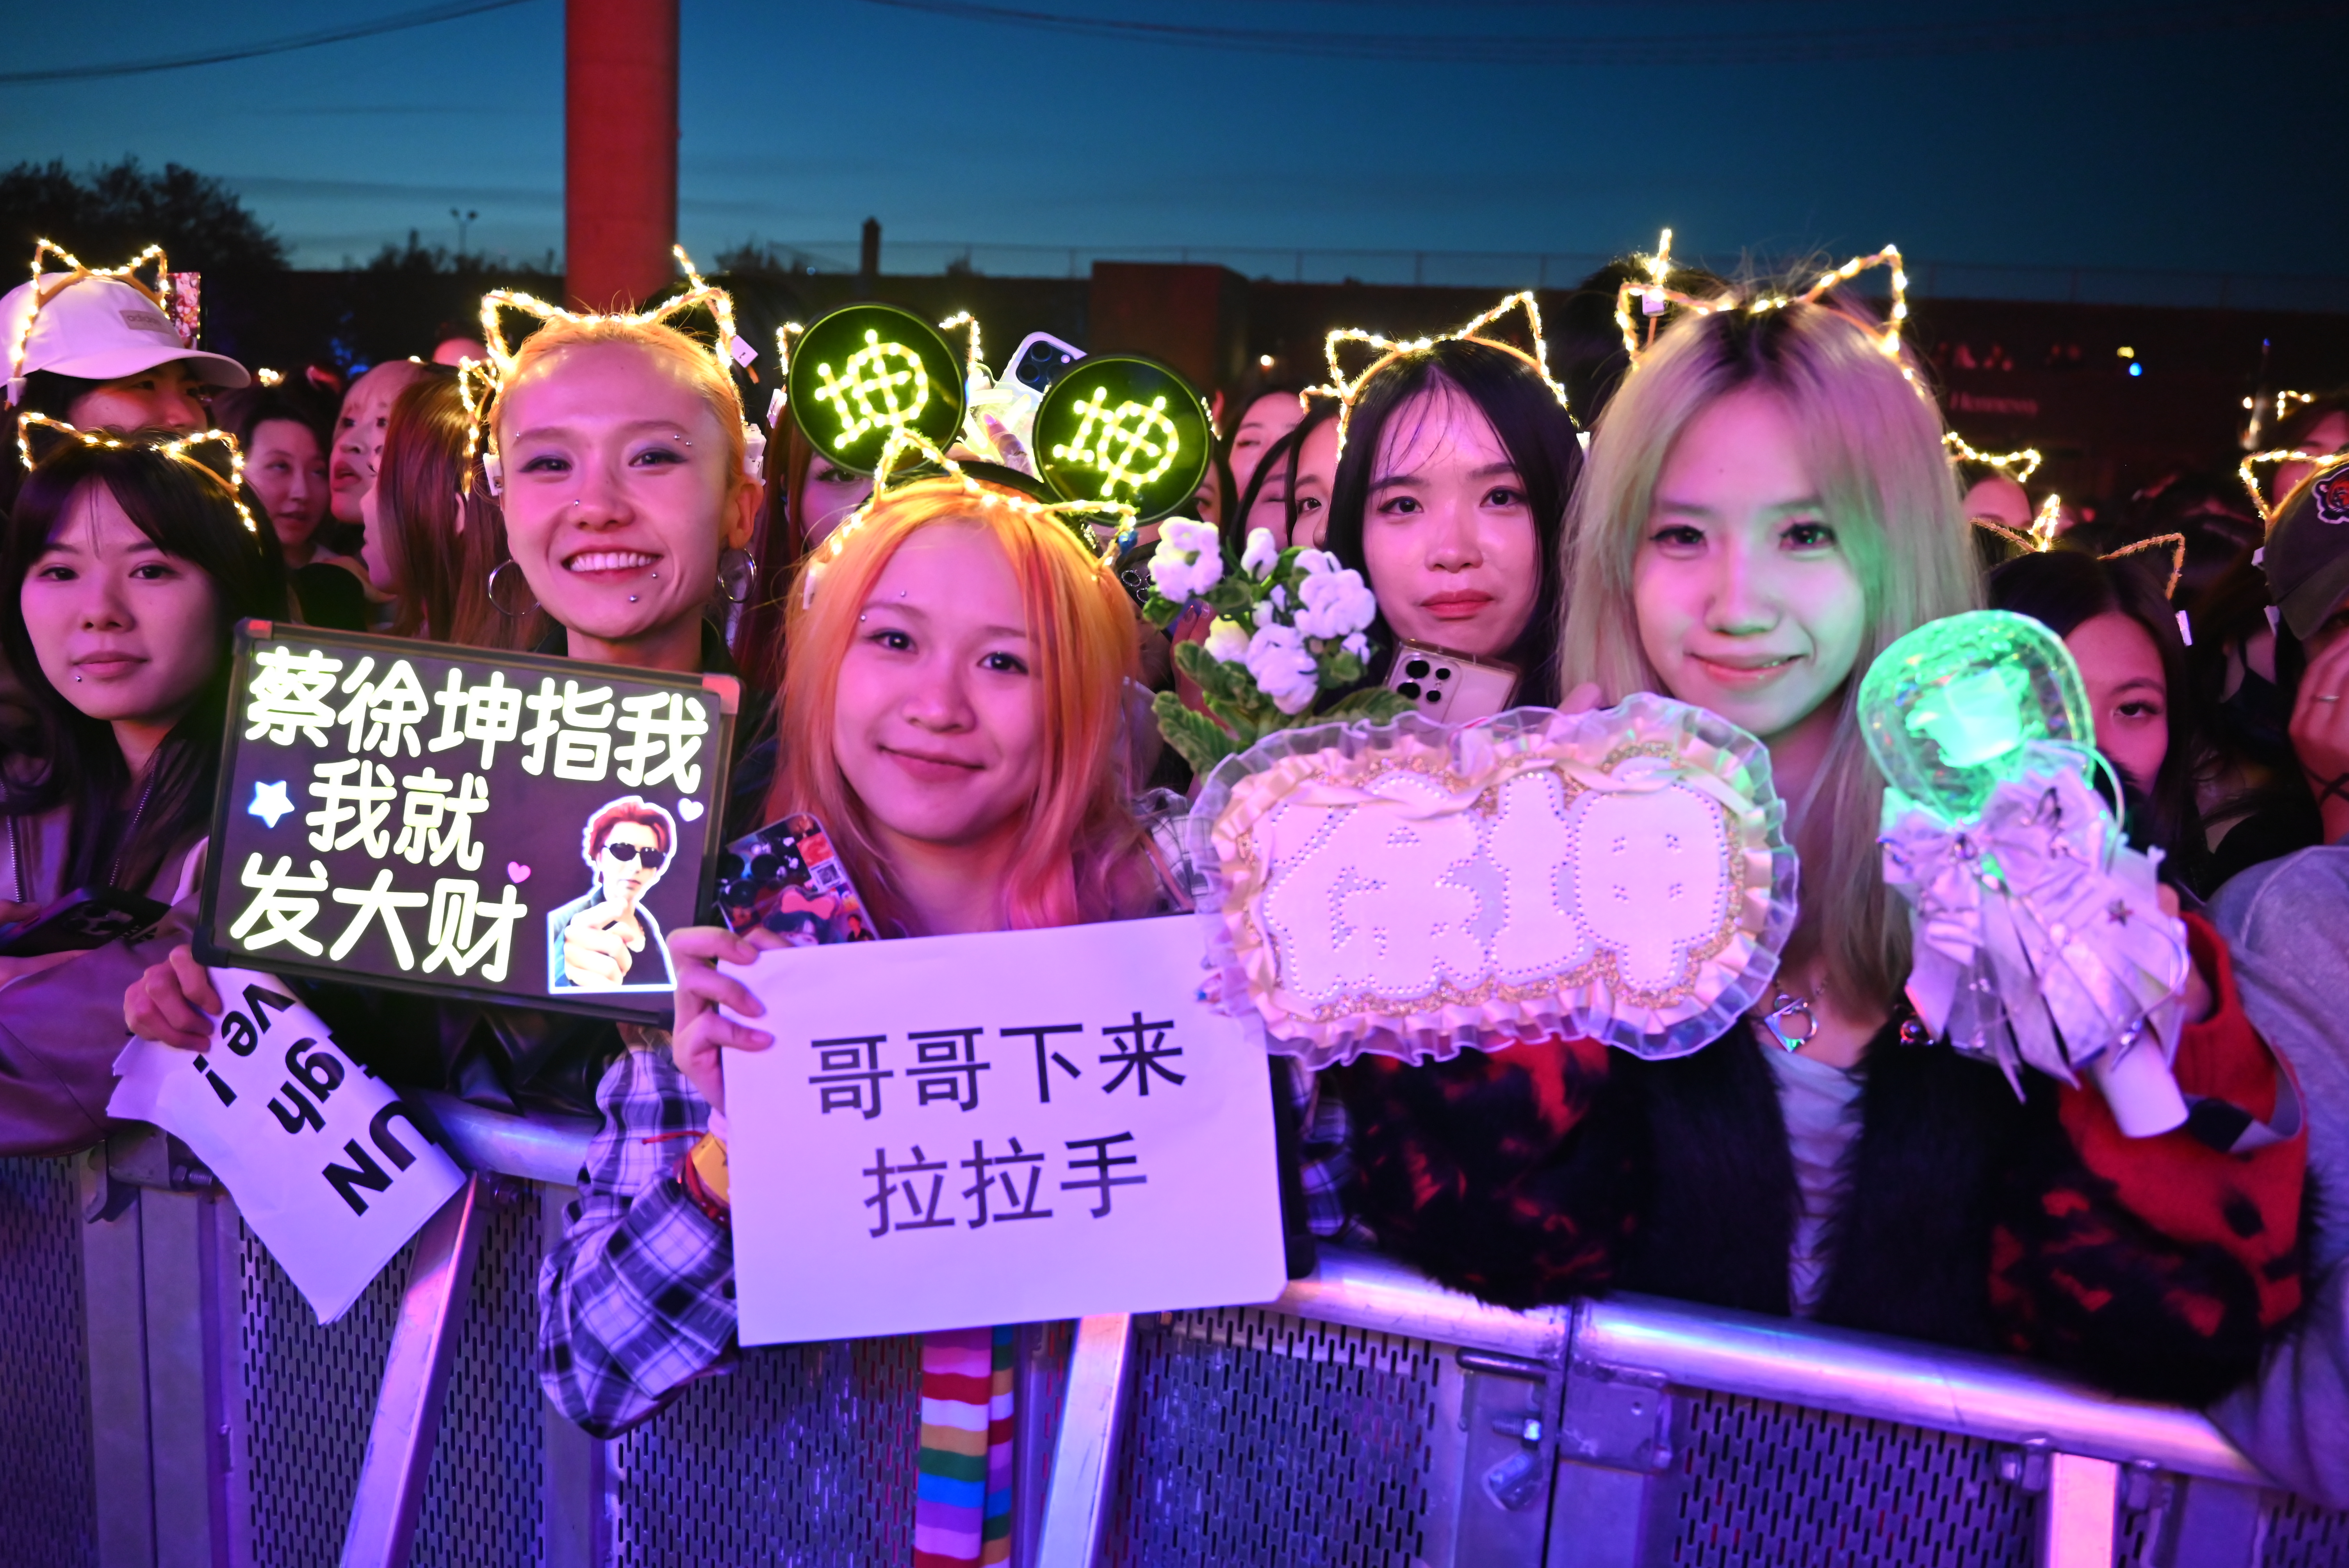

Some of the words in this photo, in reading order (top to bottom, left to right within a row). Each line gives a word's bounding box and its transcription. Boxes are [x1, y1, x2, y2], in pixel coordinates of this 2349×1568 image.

[814, 328, 929, 450] 坤
[1052, 385, 1180, 498] 坤
[244, 645, 710, 795] 蔡徐坤指我
[304, 757, 490, 872] 我就
[233, 852, 529, 983] 发大财
[809, 1012, 1186, 1120] 哥哥下来
[863, 1131, 1148, 1238] 拉拉手
